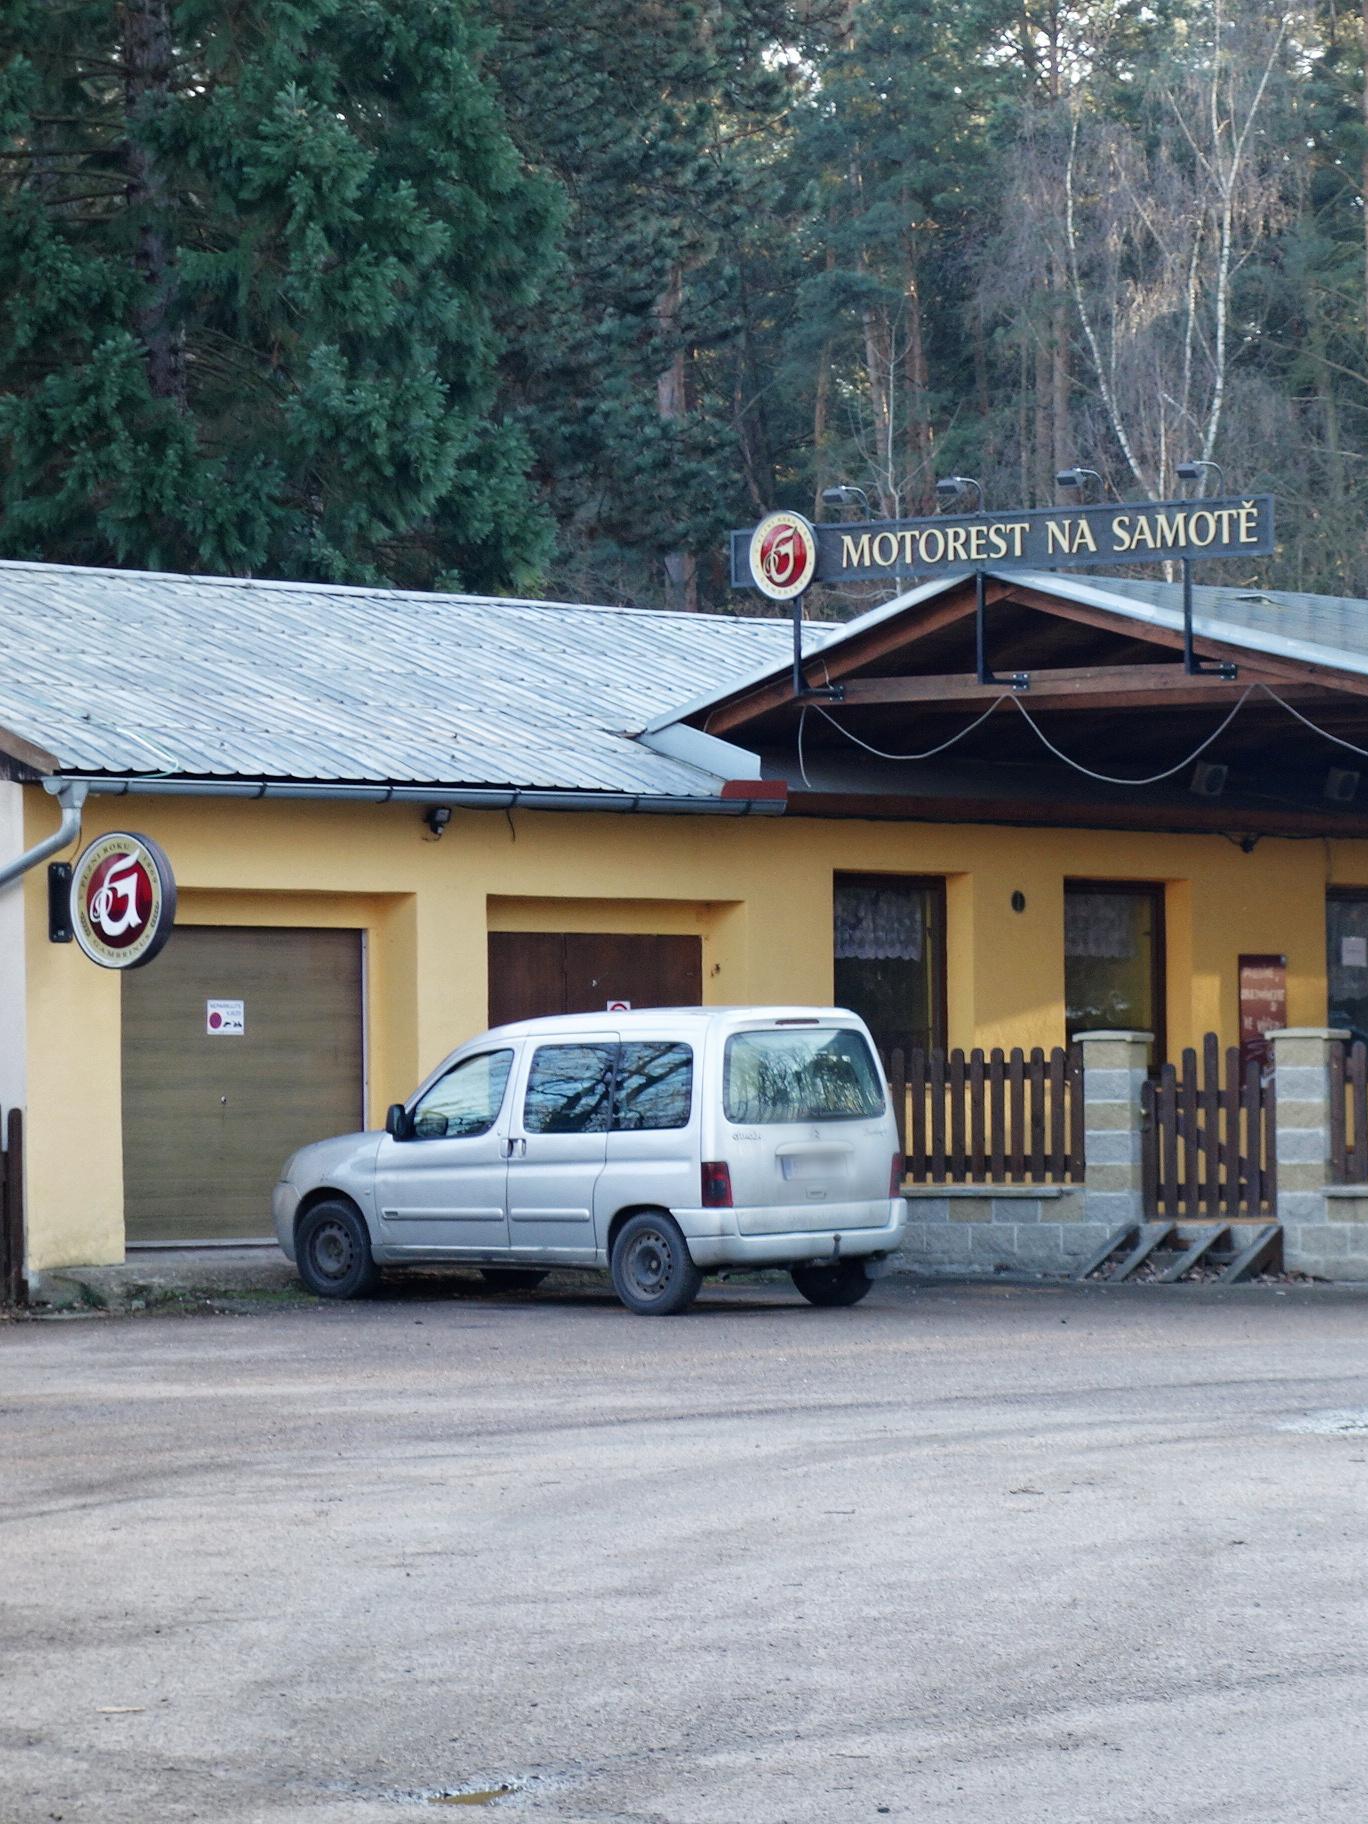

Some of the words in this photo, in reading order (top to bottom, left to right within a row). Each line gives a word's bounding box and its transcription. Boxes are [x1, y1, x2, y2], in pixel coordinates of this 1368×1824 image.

[841, 523, 1030, 568] MOTOREST
[1045, 518, 1097, 554] NA
[1112, 500, 1258, 551] SAMOTĚ
